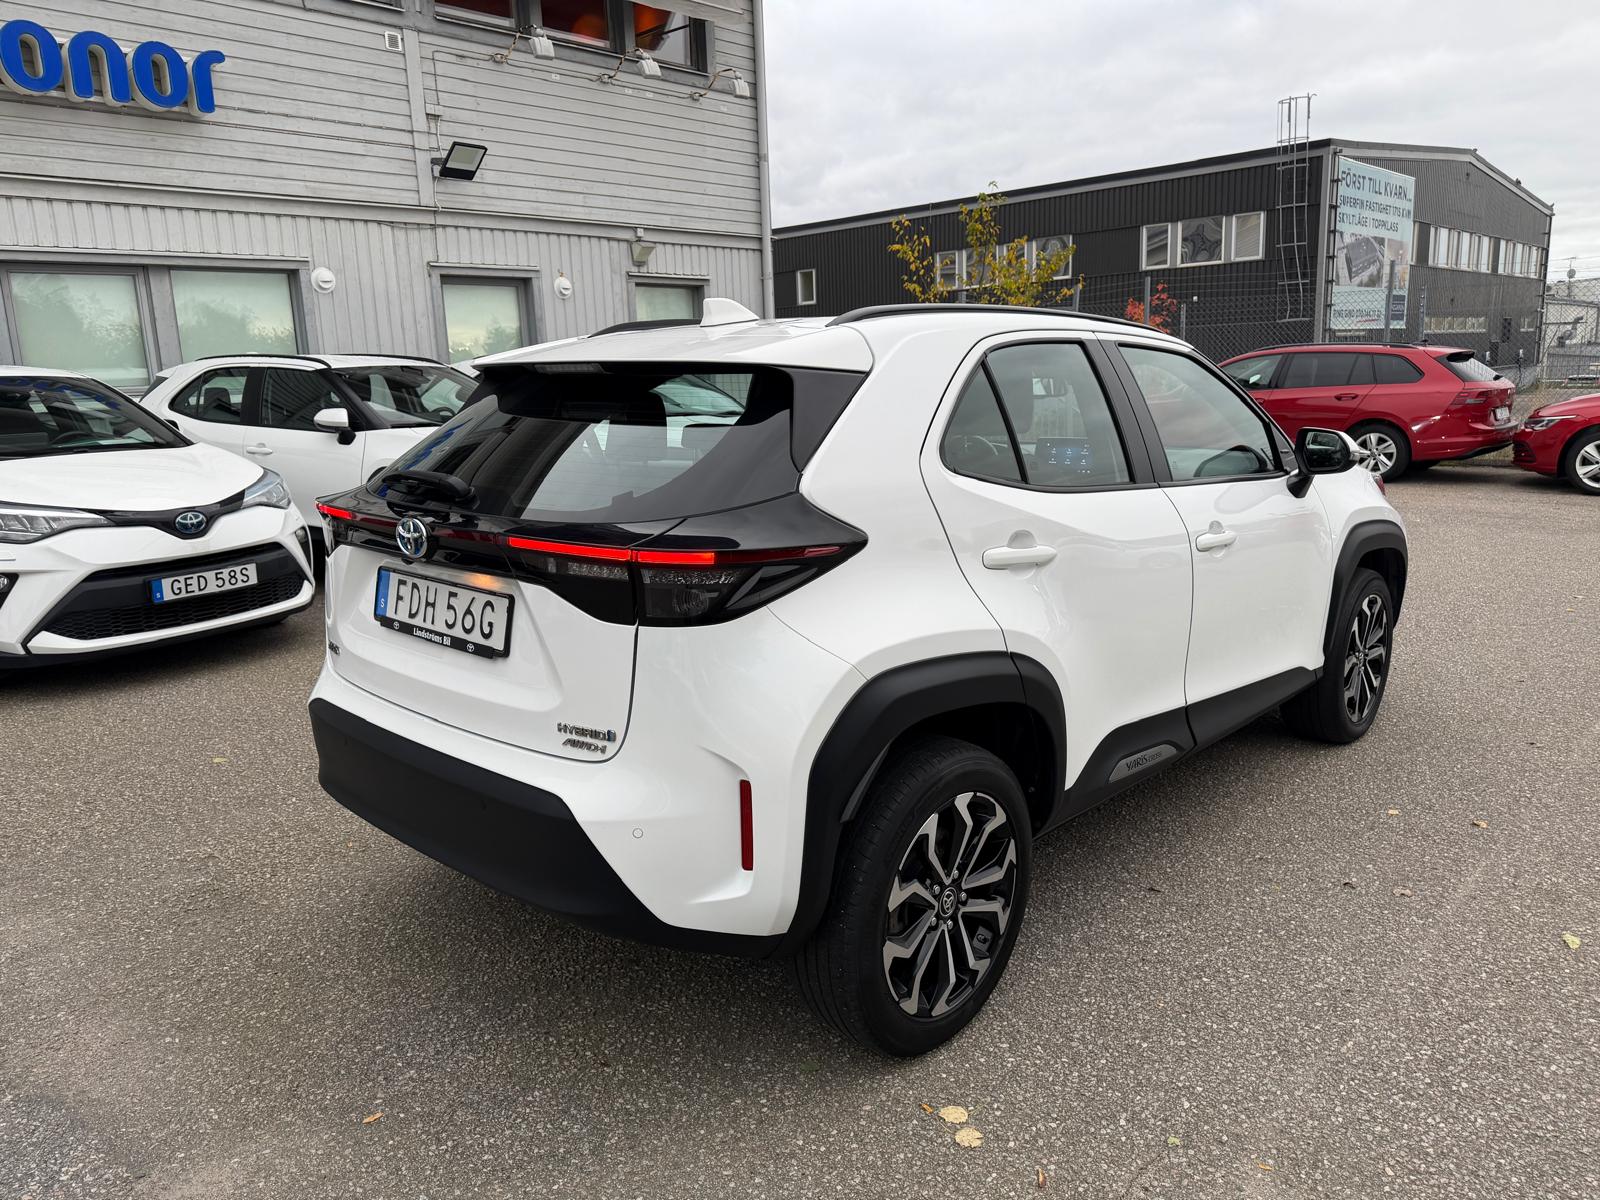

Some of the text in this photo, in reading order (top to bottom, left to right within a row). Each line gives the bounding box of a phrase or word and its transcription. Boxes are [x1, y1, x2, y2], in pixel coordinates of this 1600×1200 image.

[1341, 168, 1366, 191] FÖRST
[1368, 177, 1382, 195] TILL
[1365, 200, 1392, 215] FASTIGHET
[1338, 212, 1368, 227] SKYLTLÄGE
[1372, 218, 1399, 232] TOPPKLASS
[171, 575, 208, 596] GED
[215, 567, 250, 588] 58S
[380, 579, 495, 640] S FDH 56G
[413, 627, 451, 646] Lindströms Bil
[556, 722, 607, 741] HYBRID
